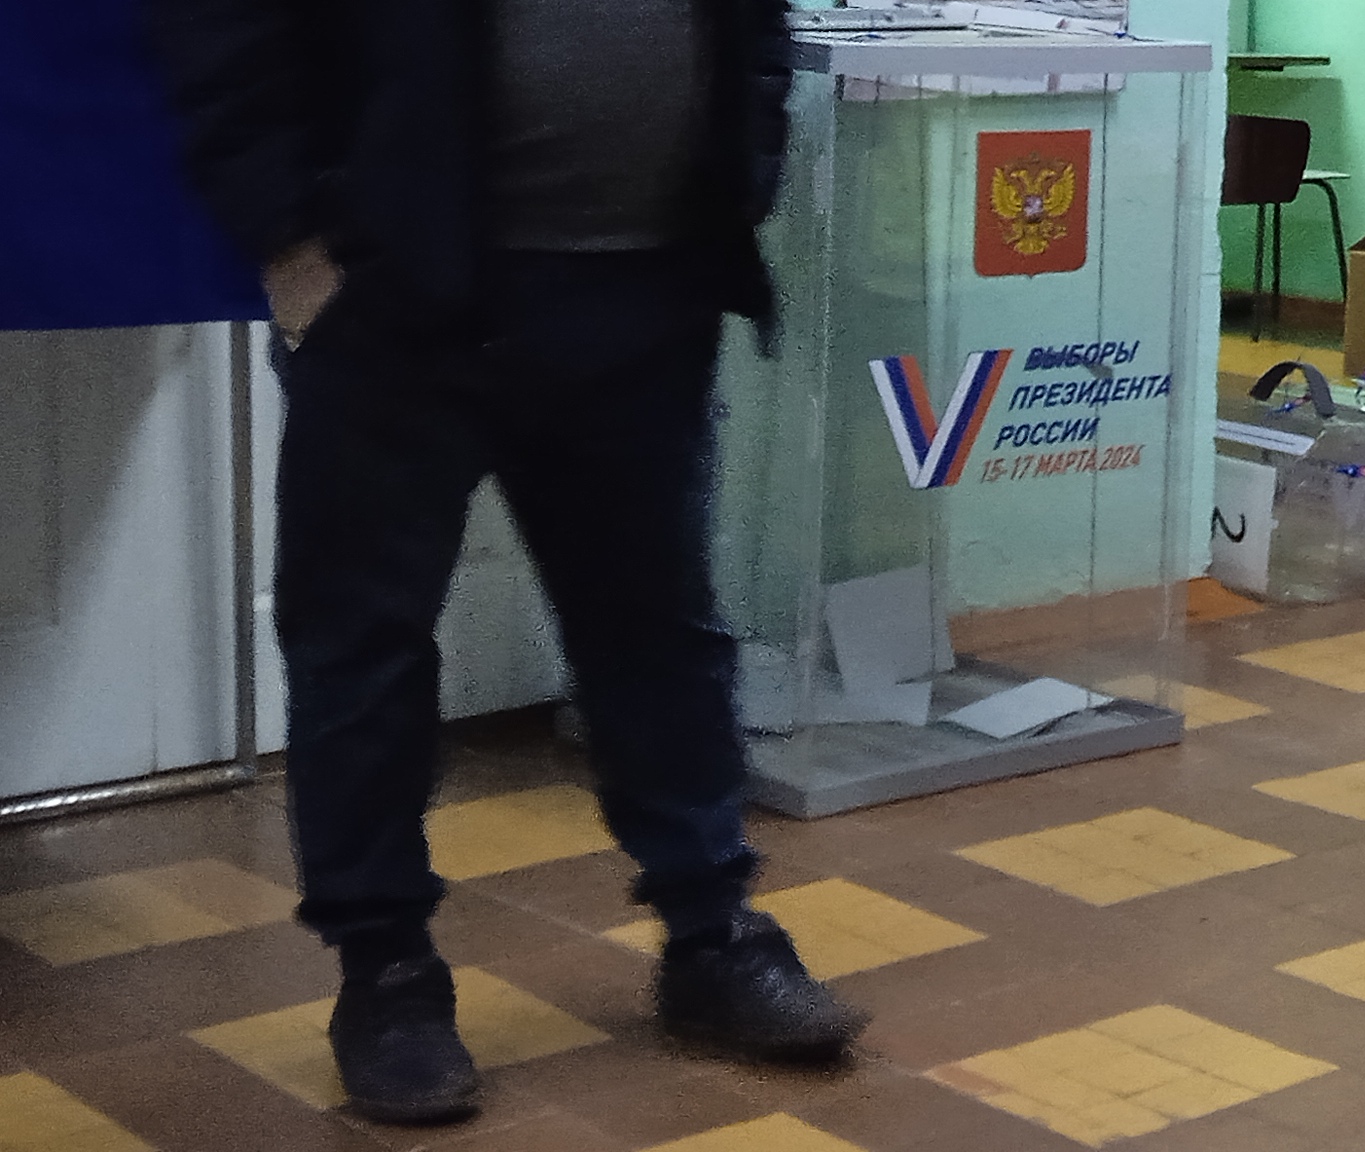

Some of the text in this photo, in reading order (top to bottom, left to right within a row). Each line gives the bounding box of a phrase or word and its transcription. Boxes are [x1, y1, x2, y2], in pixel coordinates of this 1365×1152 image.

[1023, 340, 1140, 371] ВЫБОРЫ
[1007, 373, 1174, 412] ПРЕЗИДЕНТА
[993, 417, 1101, 451] РОССИИ
[980, 455, 1034, 484] 15-17
[1033, 447, 1097, 478] МАРТА
